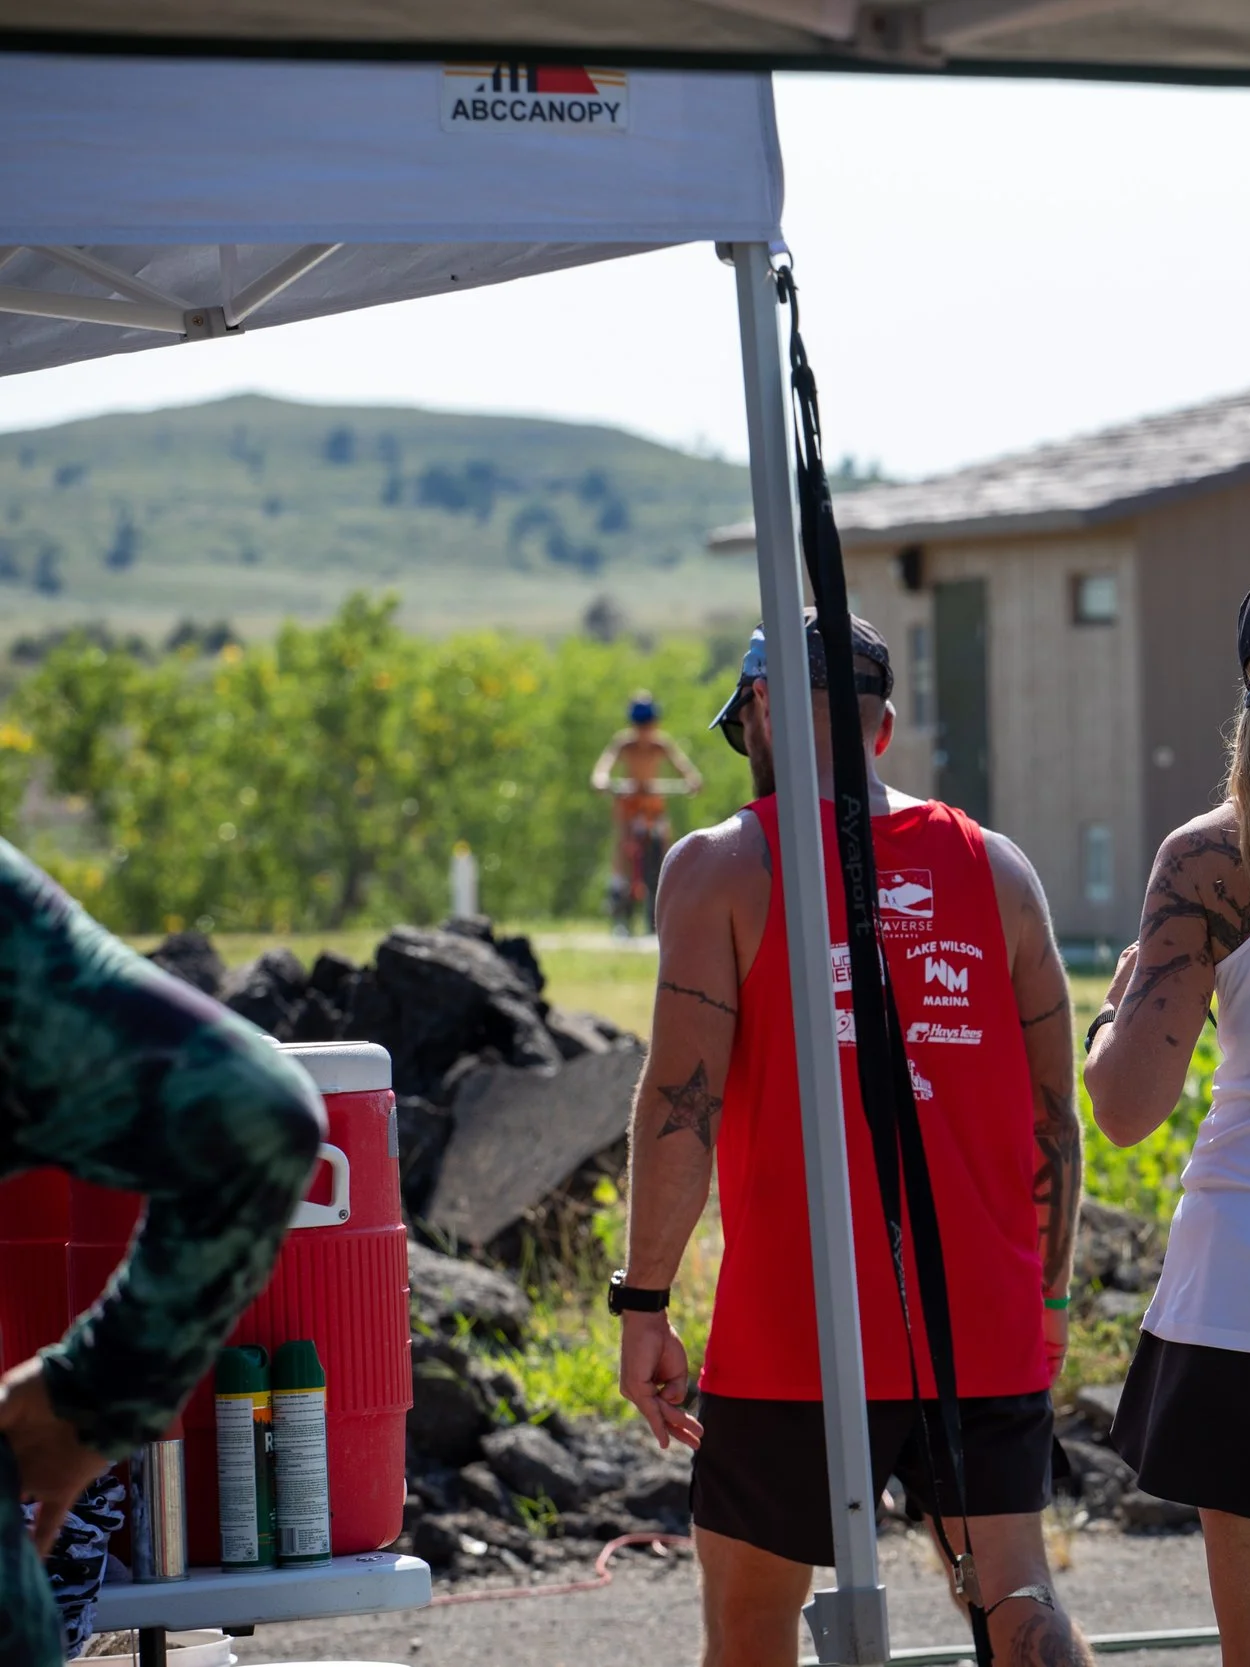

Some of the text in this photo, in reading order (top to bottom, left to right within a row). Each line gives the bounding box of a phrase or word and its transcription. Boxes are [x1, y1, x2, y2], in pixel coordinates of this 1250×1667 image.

[451, 98, 621, 123] ABCCANOPY
[841, 793, 871, 938] Ayaport
[906, 940, 983, 961] LAKE WILSON
[923, 995, 969, 1007] MARINA
